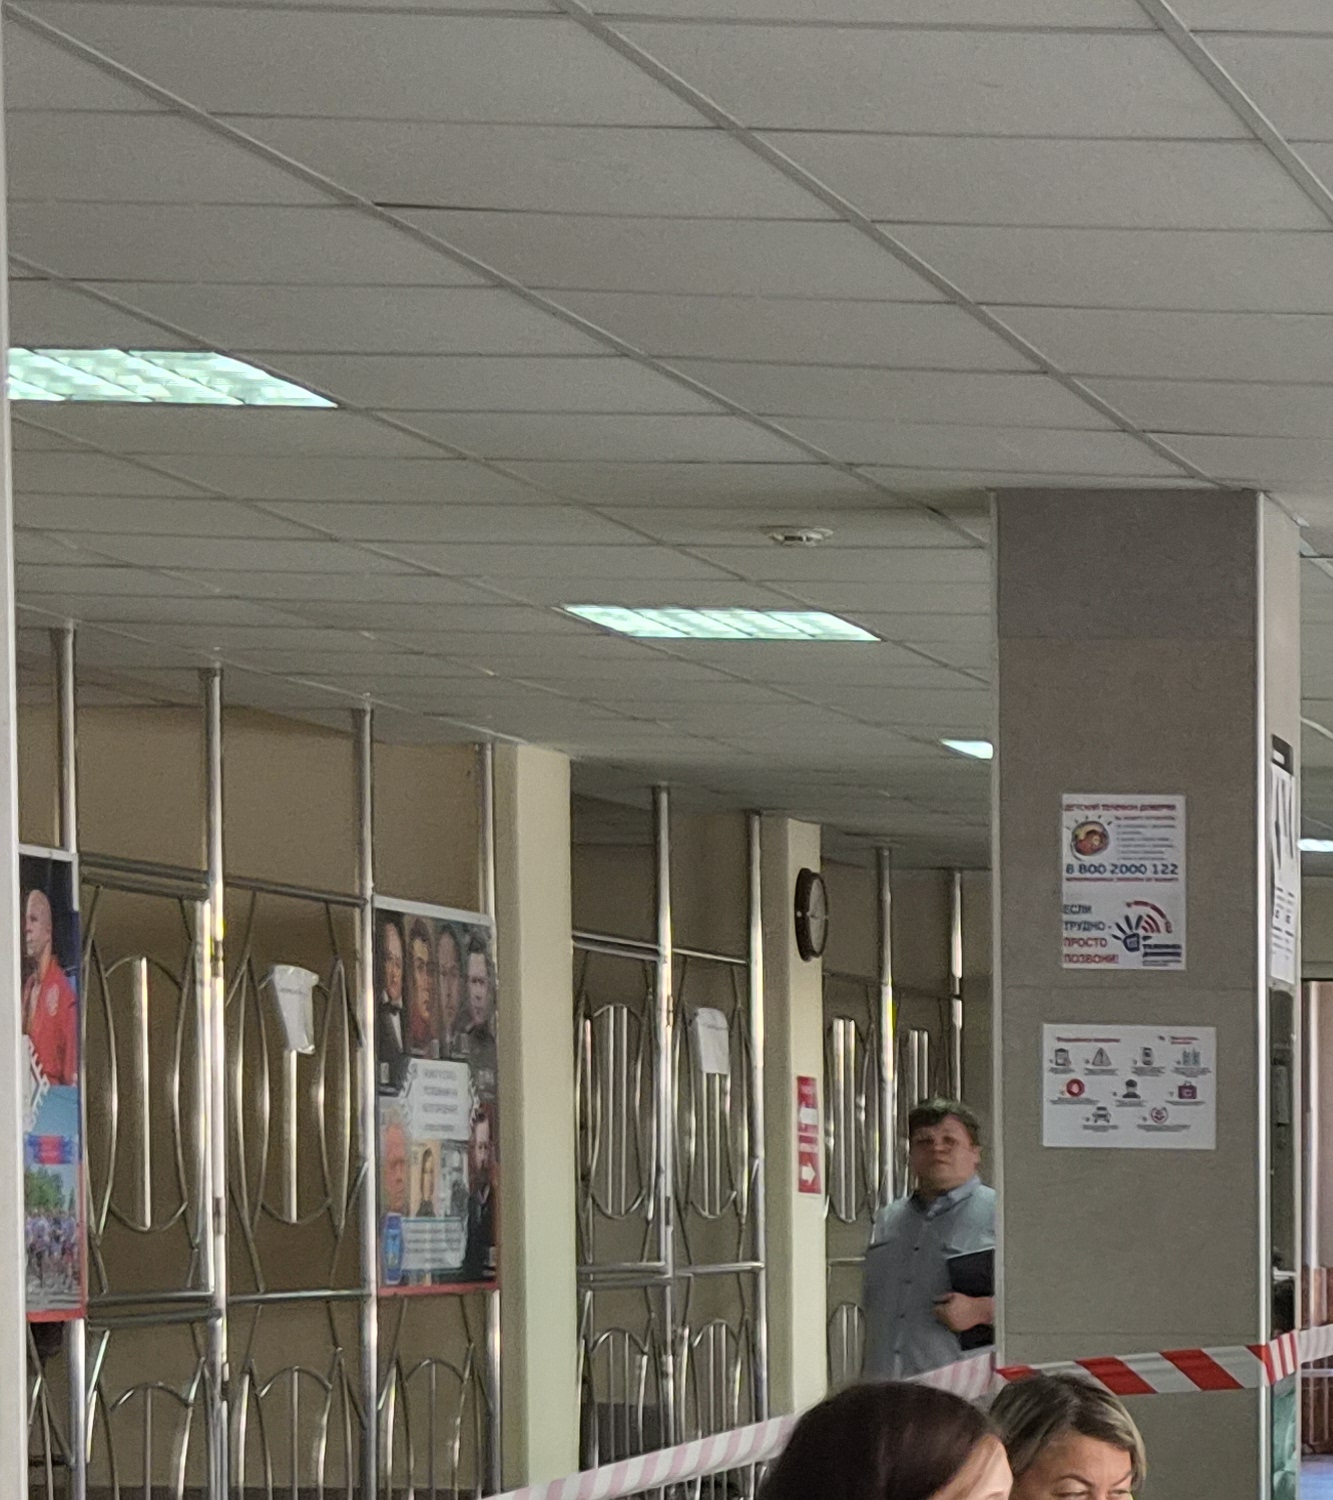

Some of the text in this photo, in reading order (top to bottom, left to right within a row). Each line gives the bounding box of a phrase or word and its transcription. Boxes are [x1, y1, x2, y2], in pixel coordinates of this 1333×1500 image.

[1078, 863, 1107, 875] 800
[1110, 863, 1148, 875] 2000
[1152, 863, 1179, 875] 122
[1064, 936, 1108, 948] ПРОСТО
